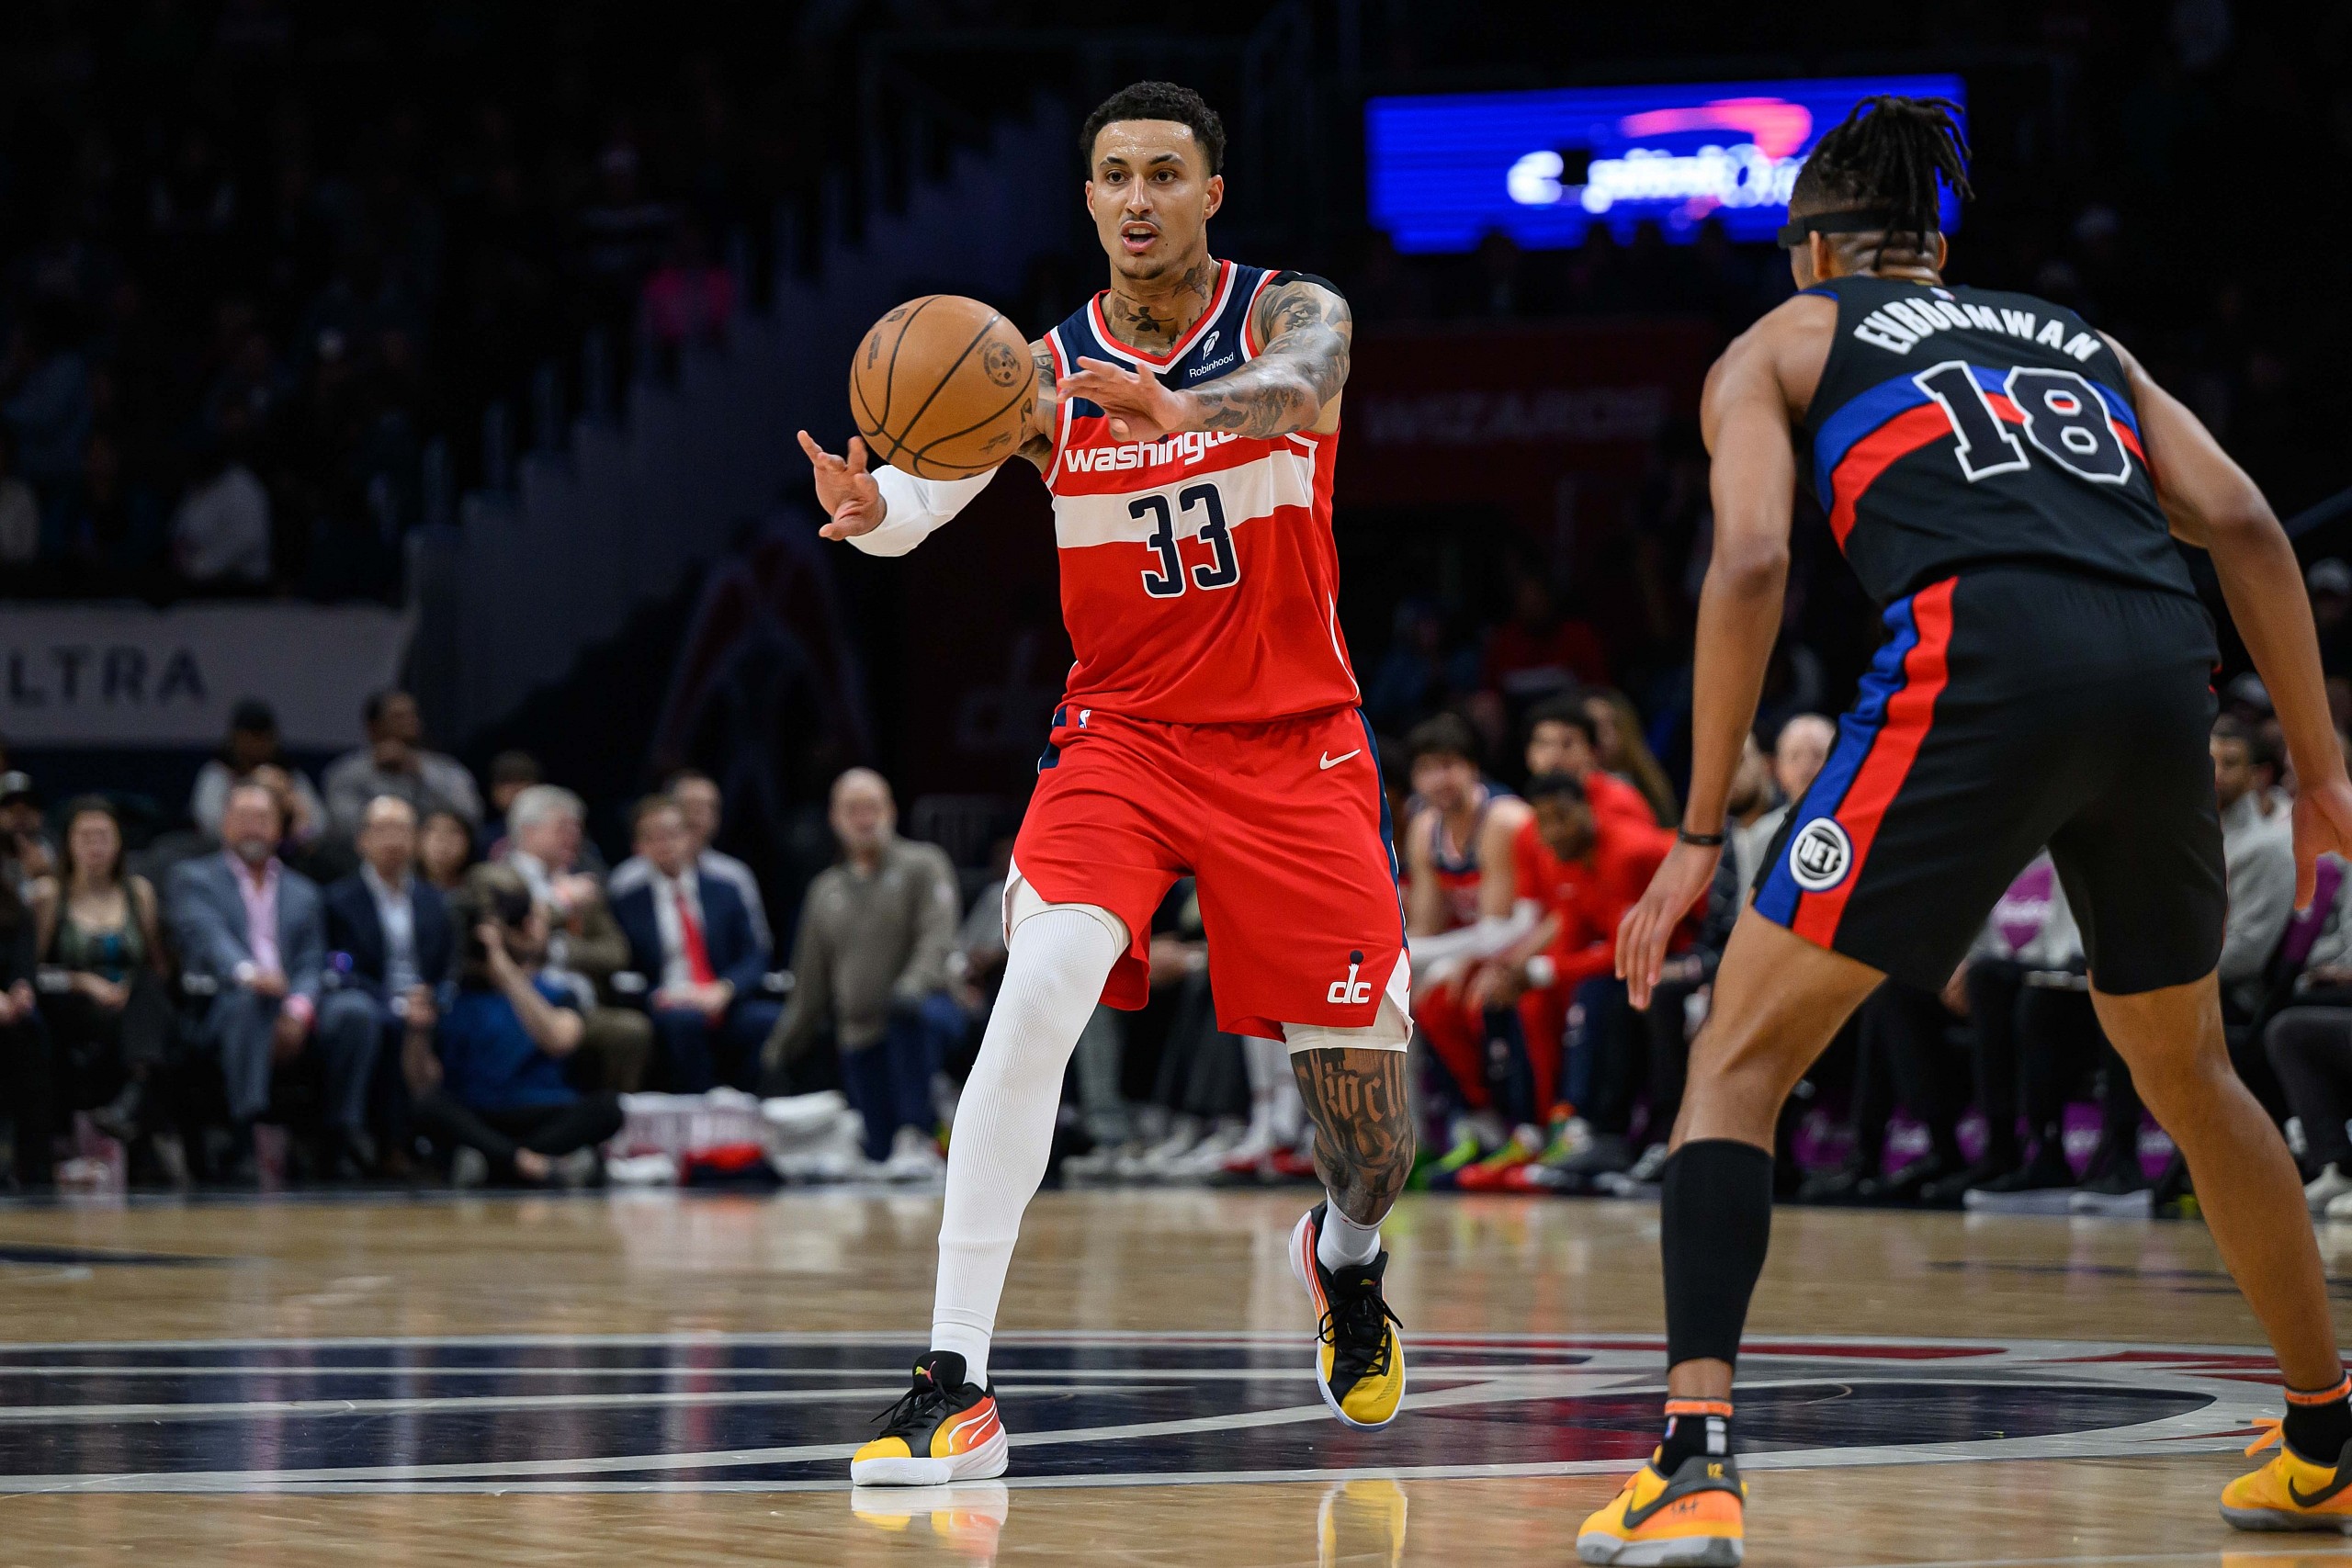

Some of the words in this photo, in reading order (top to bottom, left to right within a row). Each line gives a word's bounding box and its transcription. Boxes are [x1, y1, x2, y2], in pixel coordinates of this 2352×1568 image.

[1853, 297, 2101, 363] EVBUOMWAN
[1189, 352, 1234, 378] Robinhood
[1912, 360, 2132, 485] 18
[1127, 479, 1241, 599] 33
[1799, 832, 1840, 874] DET
